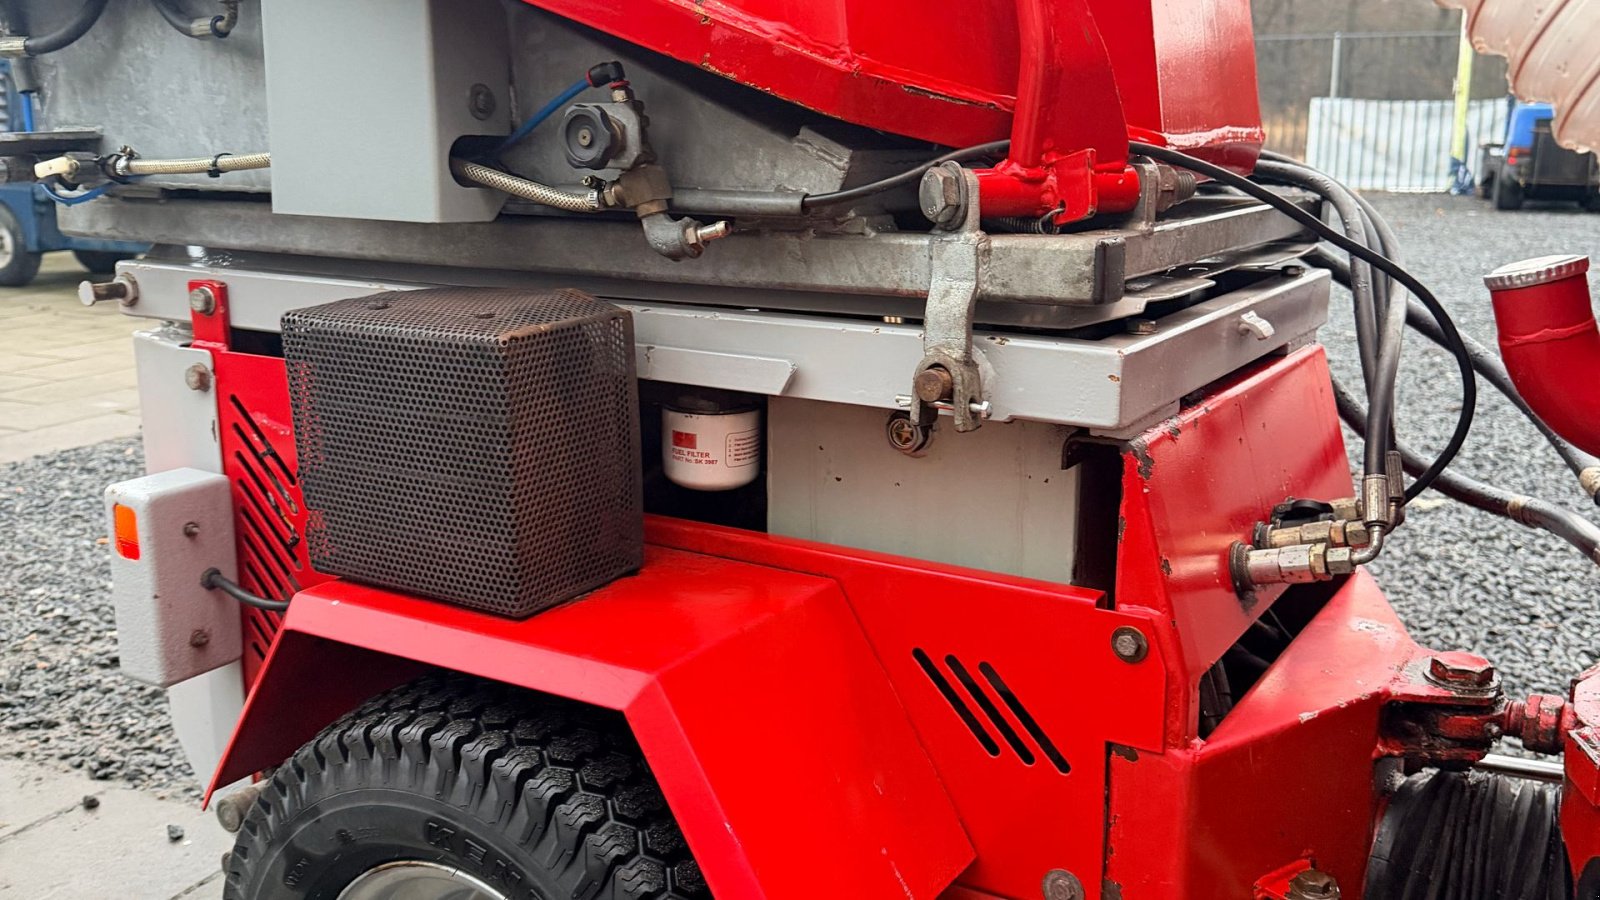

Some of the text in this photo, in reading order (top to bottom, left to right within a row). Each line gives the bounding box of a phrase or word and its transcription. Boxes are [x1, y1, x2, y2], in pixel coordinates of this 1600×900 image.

[672, 447, 710, 459] FUEL FILTER
[672, 454, 684, 462] PART
